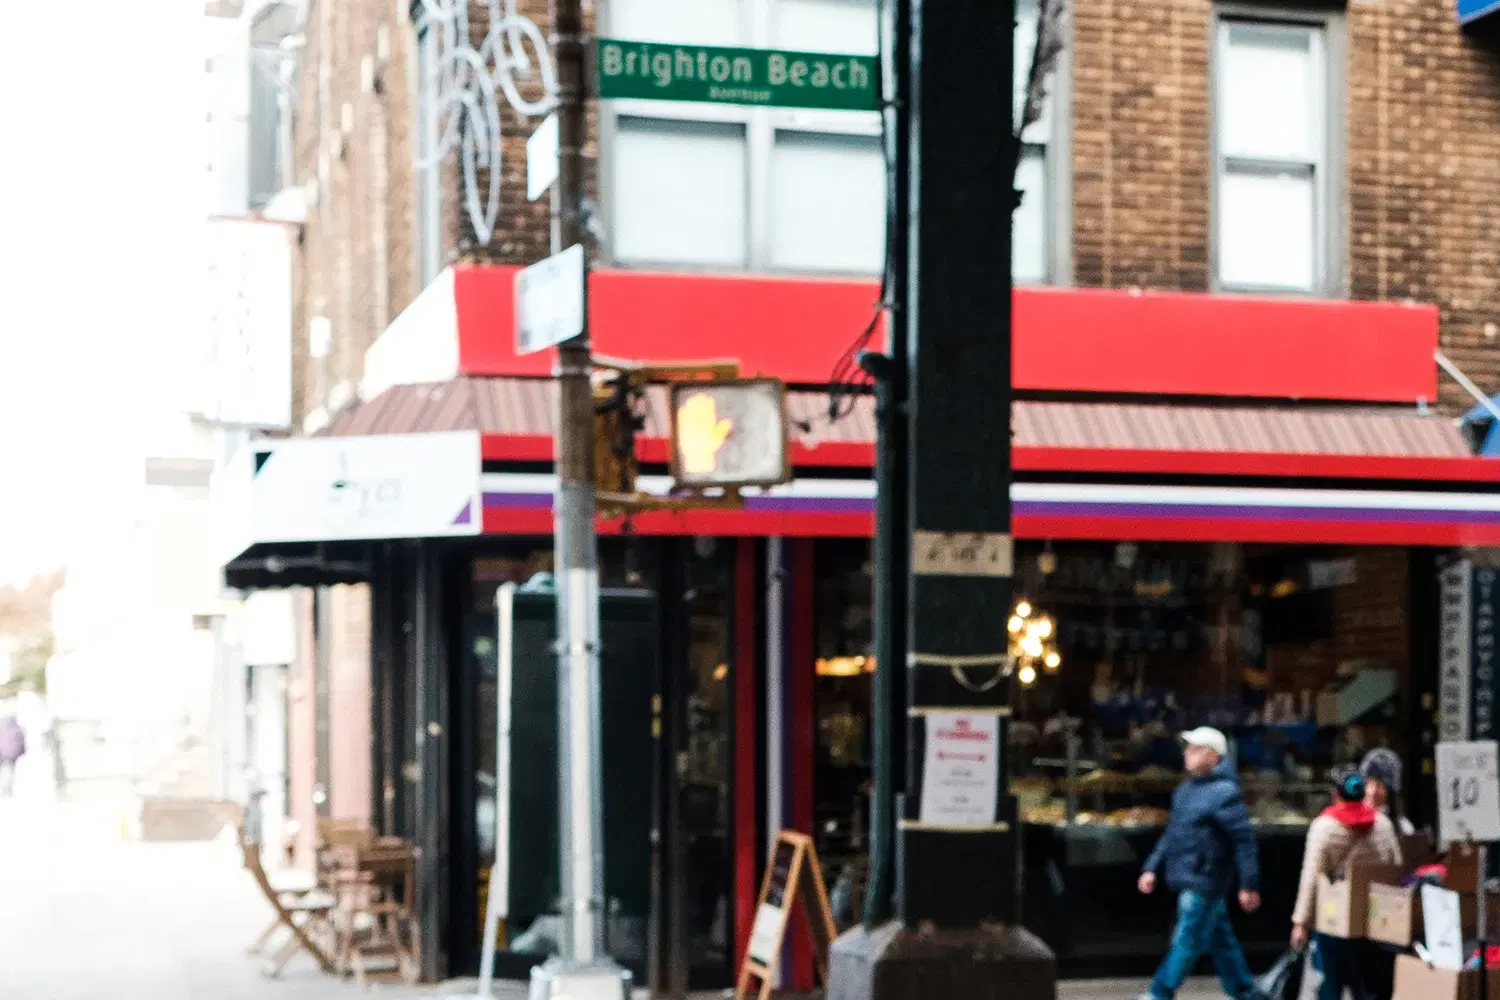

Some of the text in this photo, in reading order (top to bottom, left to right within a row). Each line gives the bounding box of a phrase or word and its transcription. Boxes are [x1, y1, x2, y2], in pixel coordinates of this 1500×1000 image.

[602, 44, 869, 89] Brighton Beach
[1450, 774, 1480, 813] 10
